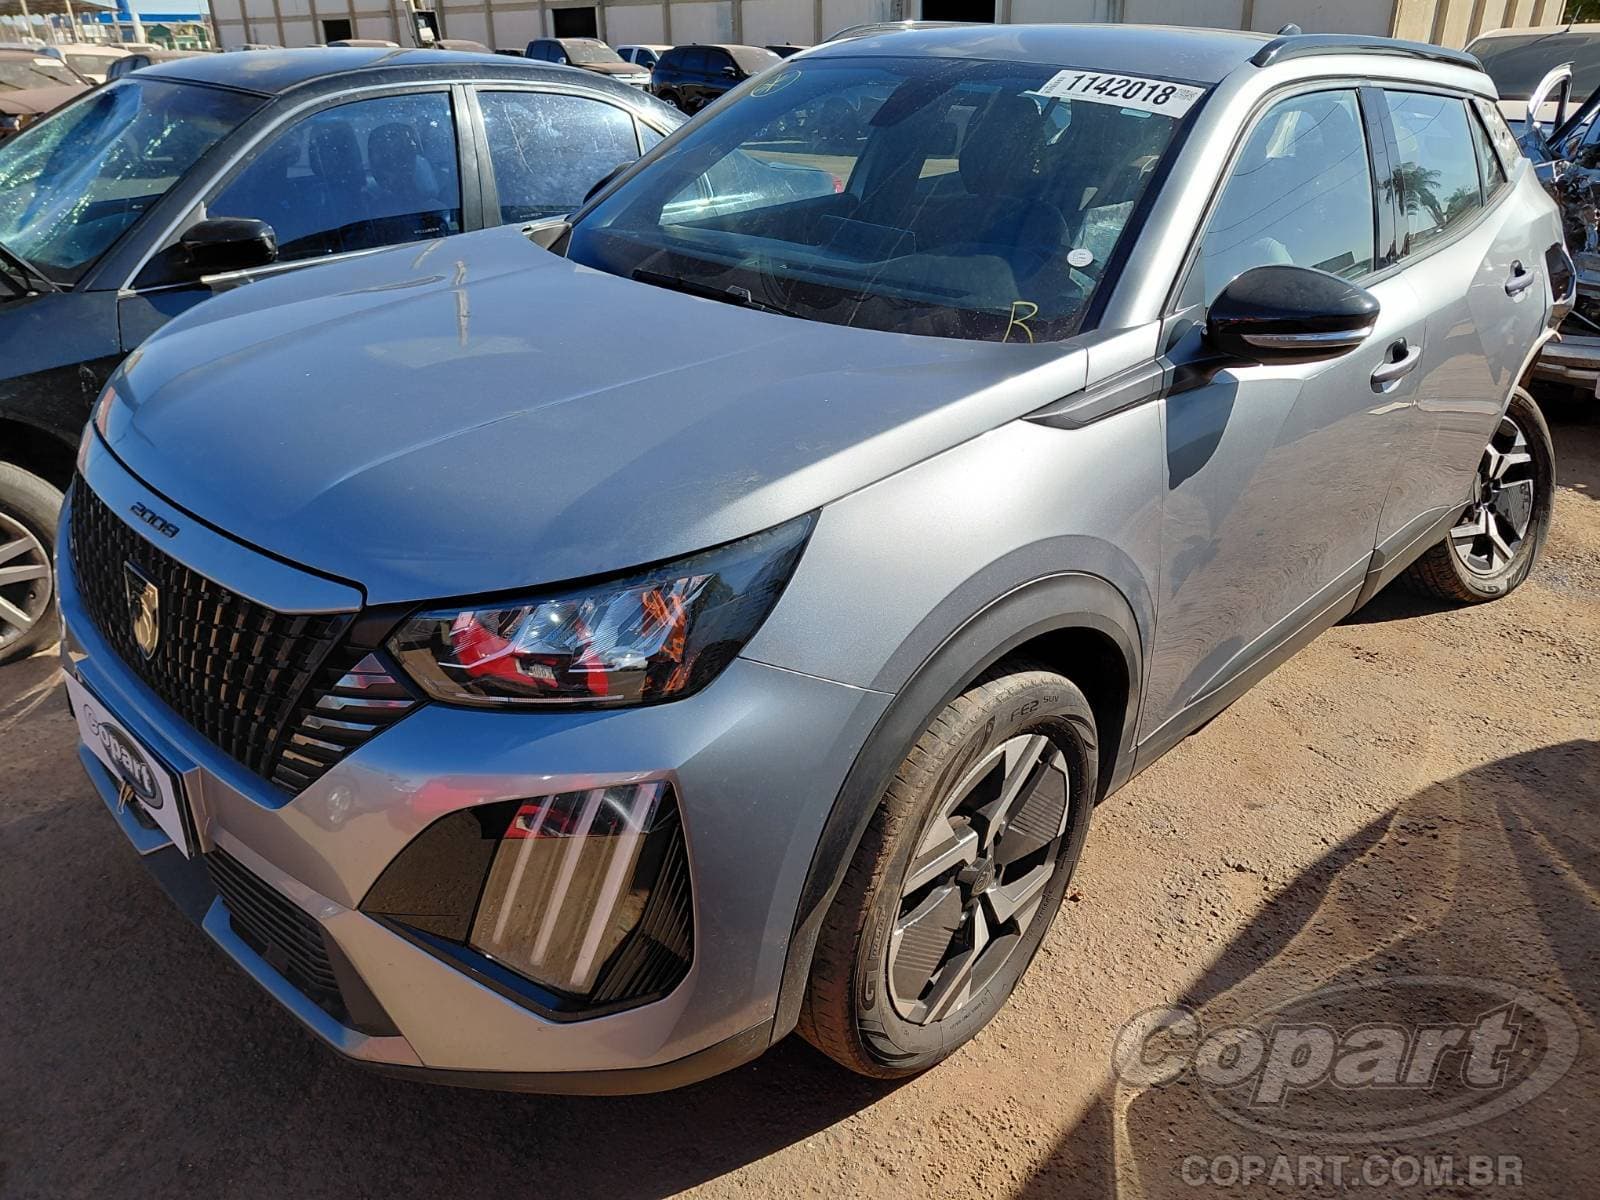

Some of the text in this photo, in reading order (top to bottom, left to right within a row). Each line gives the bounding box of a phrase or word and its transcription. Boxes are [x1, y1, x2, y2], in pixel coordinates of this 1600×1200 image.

[1067, 74, 1177, 106] 1142018
[1003, 300, 1038, 344] R
[131, 501, 181, 539] 2008
[1043, 694, 1060, 704] SUV
[83, 703, 155, 797] Copart
